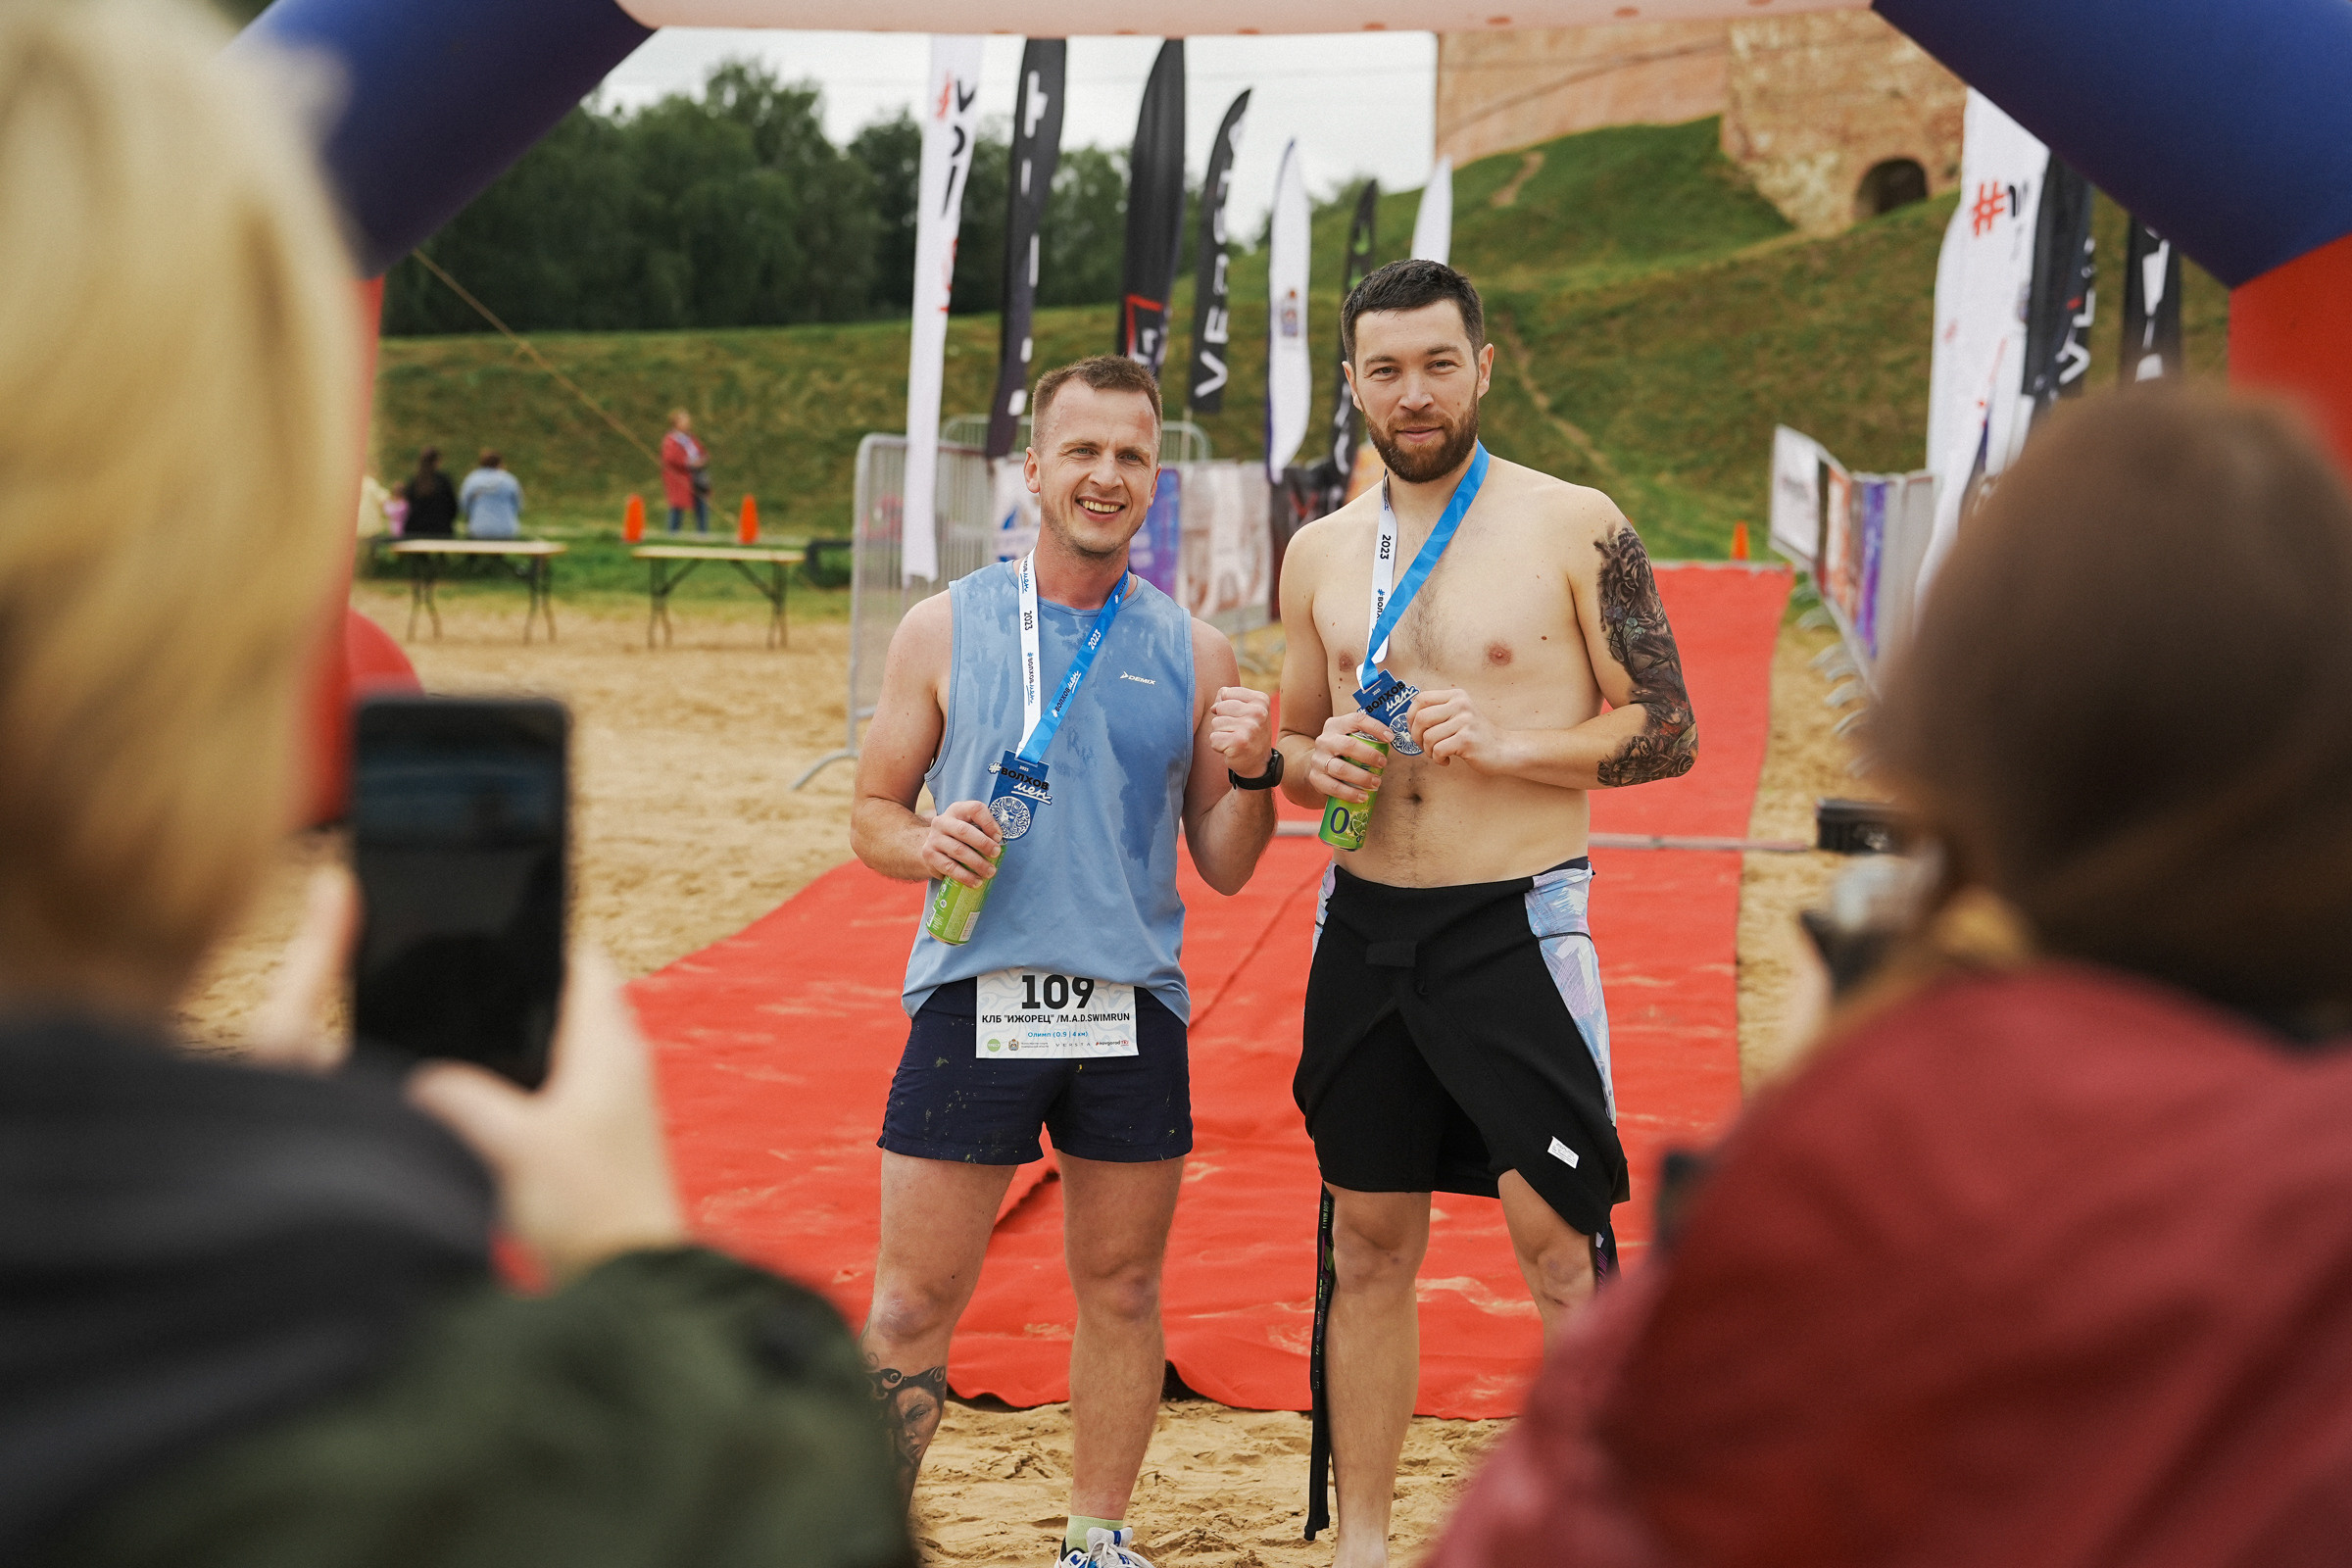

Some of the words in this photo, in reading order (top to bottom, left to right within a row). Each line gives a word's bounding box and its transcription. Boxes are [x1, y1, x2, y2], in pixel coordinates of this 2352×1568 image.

[1380, 534, 1392, 560] 2023
[1023, 610, 1033, 631] 2023
[1088, 628, 1102, 651] 2023
[1128, 674, 1155, 684] DEMIX
[1021, 974, 1095, 1009] 109
[982, 1014, 1002, 1023] КЛБ
[1004, 1014, 1054, 1024] "ИЖОРЕЦ"
[1056, 1012, 1130, 1023] /M.A.D.SWIMRUN
